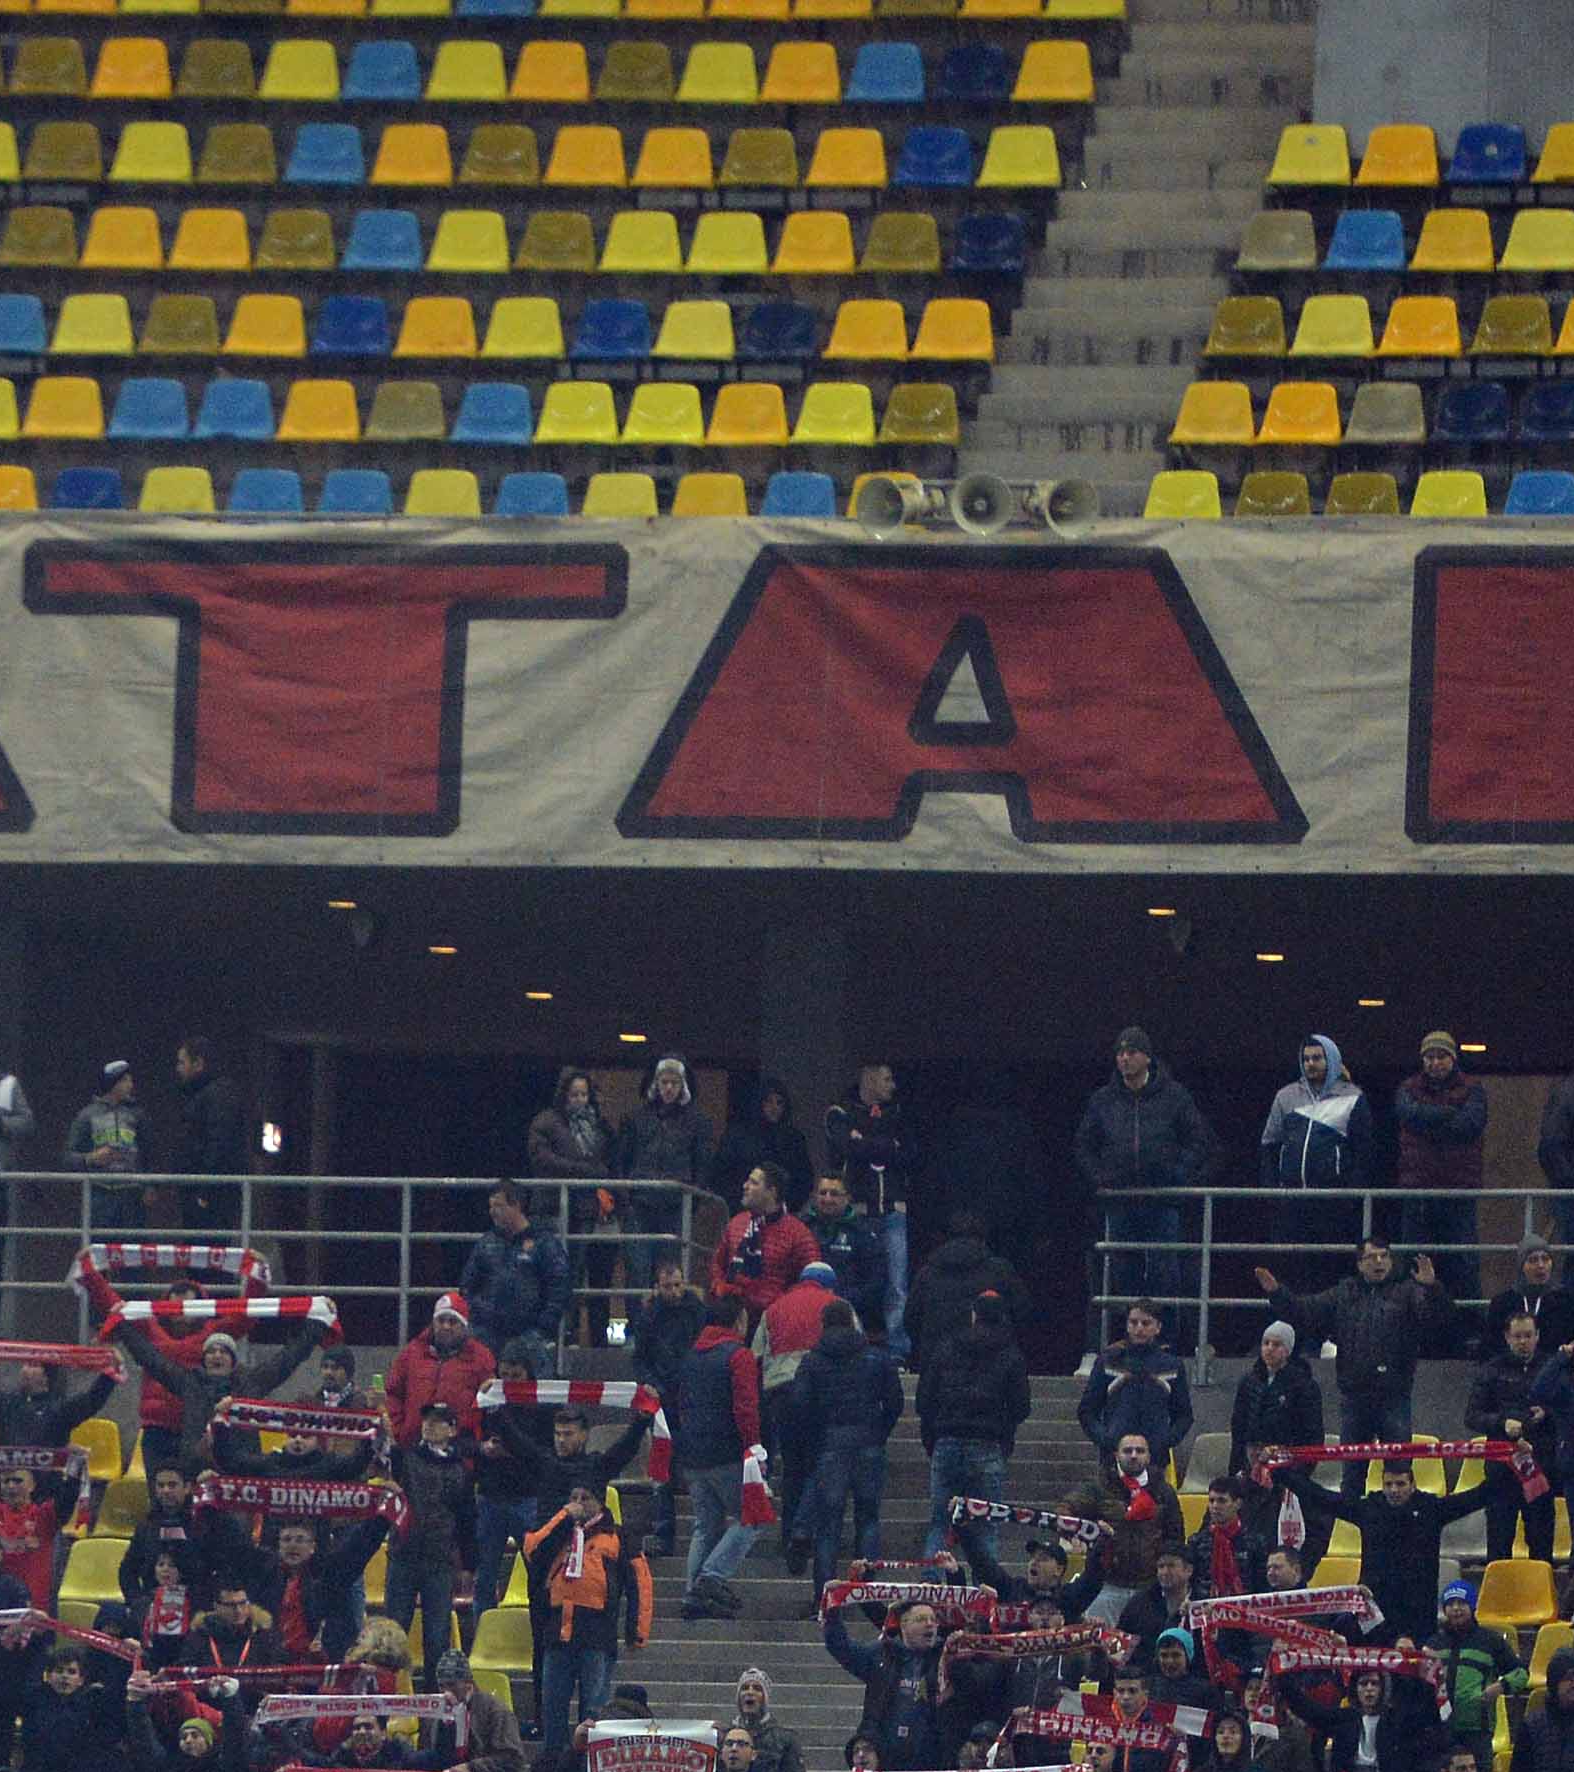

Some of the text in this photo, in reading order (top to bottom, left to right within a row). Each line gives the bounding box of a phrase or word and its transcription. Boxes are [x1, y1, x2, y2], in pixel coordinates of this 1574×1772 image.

[221, 1482, 370, 1507] F.C. DINAMO
[851, 1587, 904, 1602] ORZA
[1278, 1649, 1404, 1669] DINAMO
[1039, 1717, 1163, 1746] DINAMO
[600, 1749, 704, 1768] DINAMO
